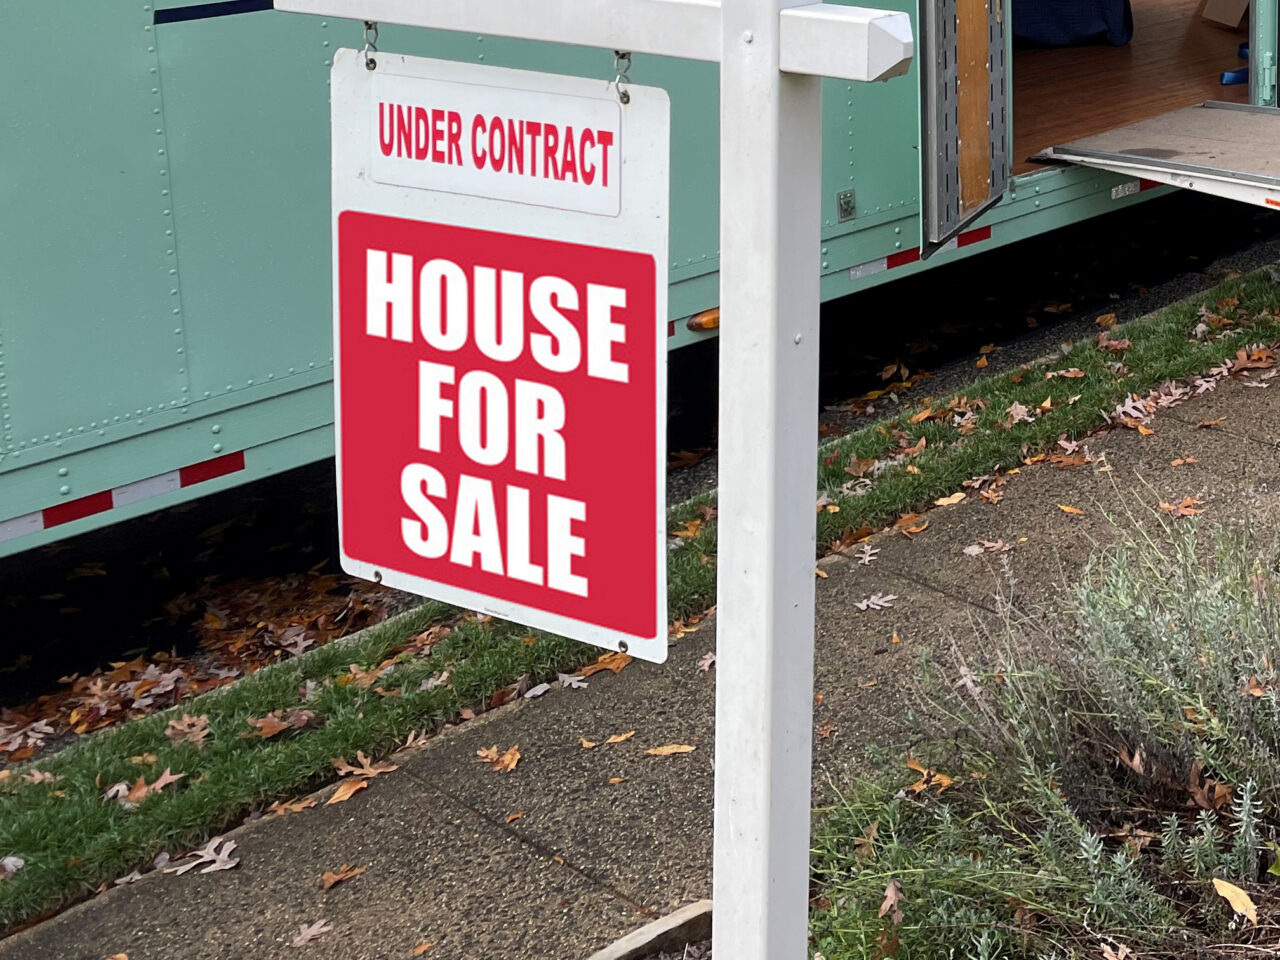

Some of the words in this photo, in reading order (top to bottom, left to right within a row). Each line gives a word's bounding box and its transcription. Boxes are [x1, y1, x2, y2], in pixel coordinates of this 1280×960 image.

[378, 101, 463, 167] UNDER
[470, 114, 614, 188] CONTRACT
[366, 248, 630, 384] HOUSE
[418, 360, 567, 482] FOR
[400, 462, 589, 598] SALE
